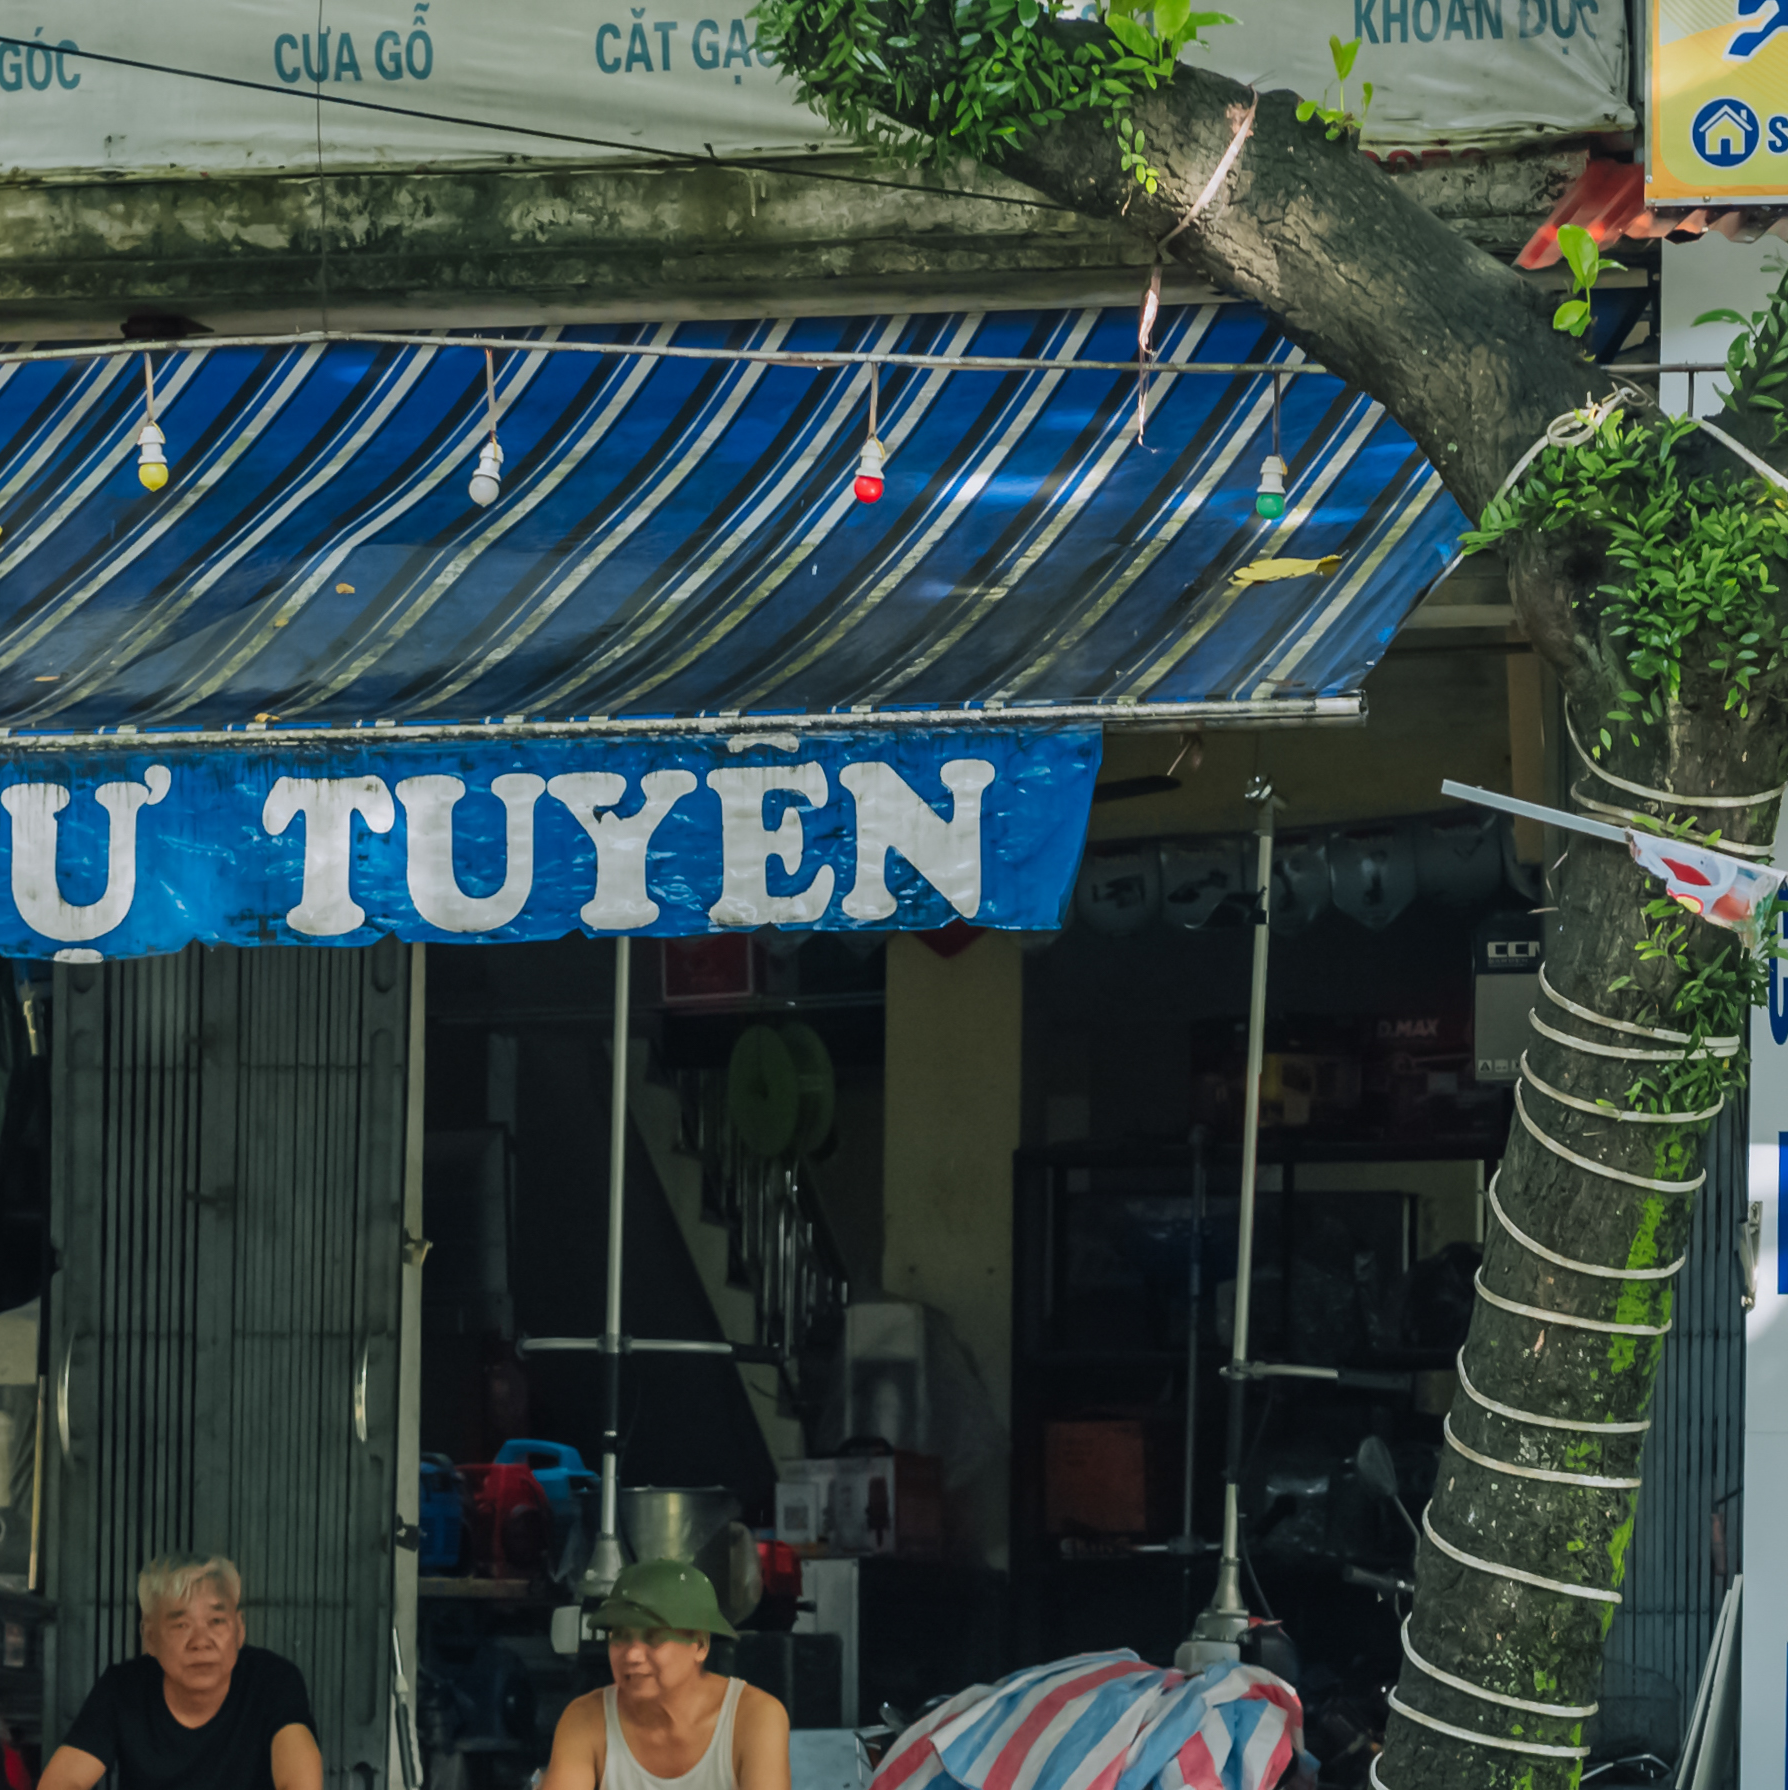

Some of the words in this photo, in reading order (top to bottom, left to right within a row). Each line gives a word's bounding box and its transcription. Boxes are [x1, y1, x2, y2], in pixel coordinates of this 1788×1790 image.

[274, 25, 361, 84] CƯA
[375, 2, 433, 82] GỖ
[1354, 0, 1503, 44] KHOAN
[262, 733, 996, 937] TUYÊN
